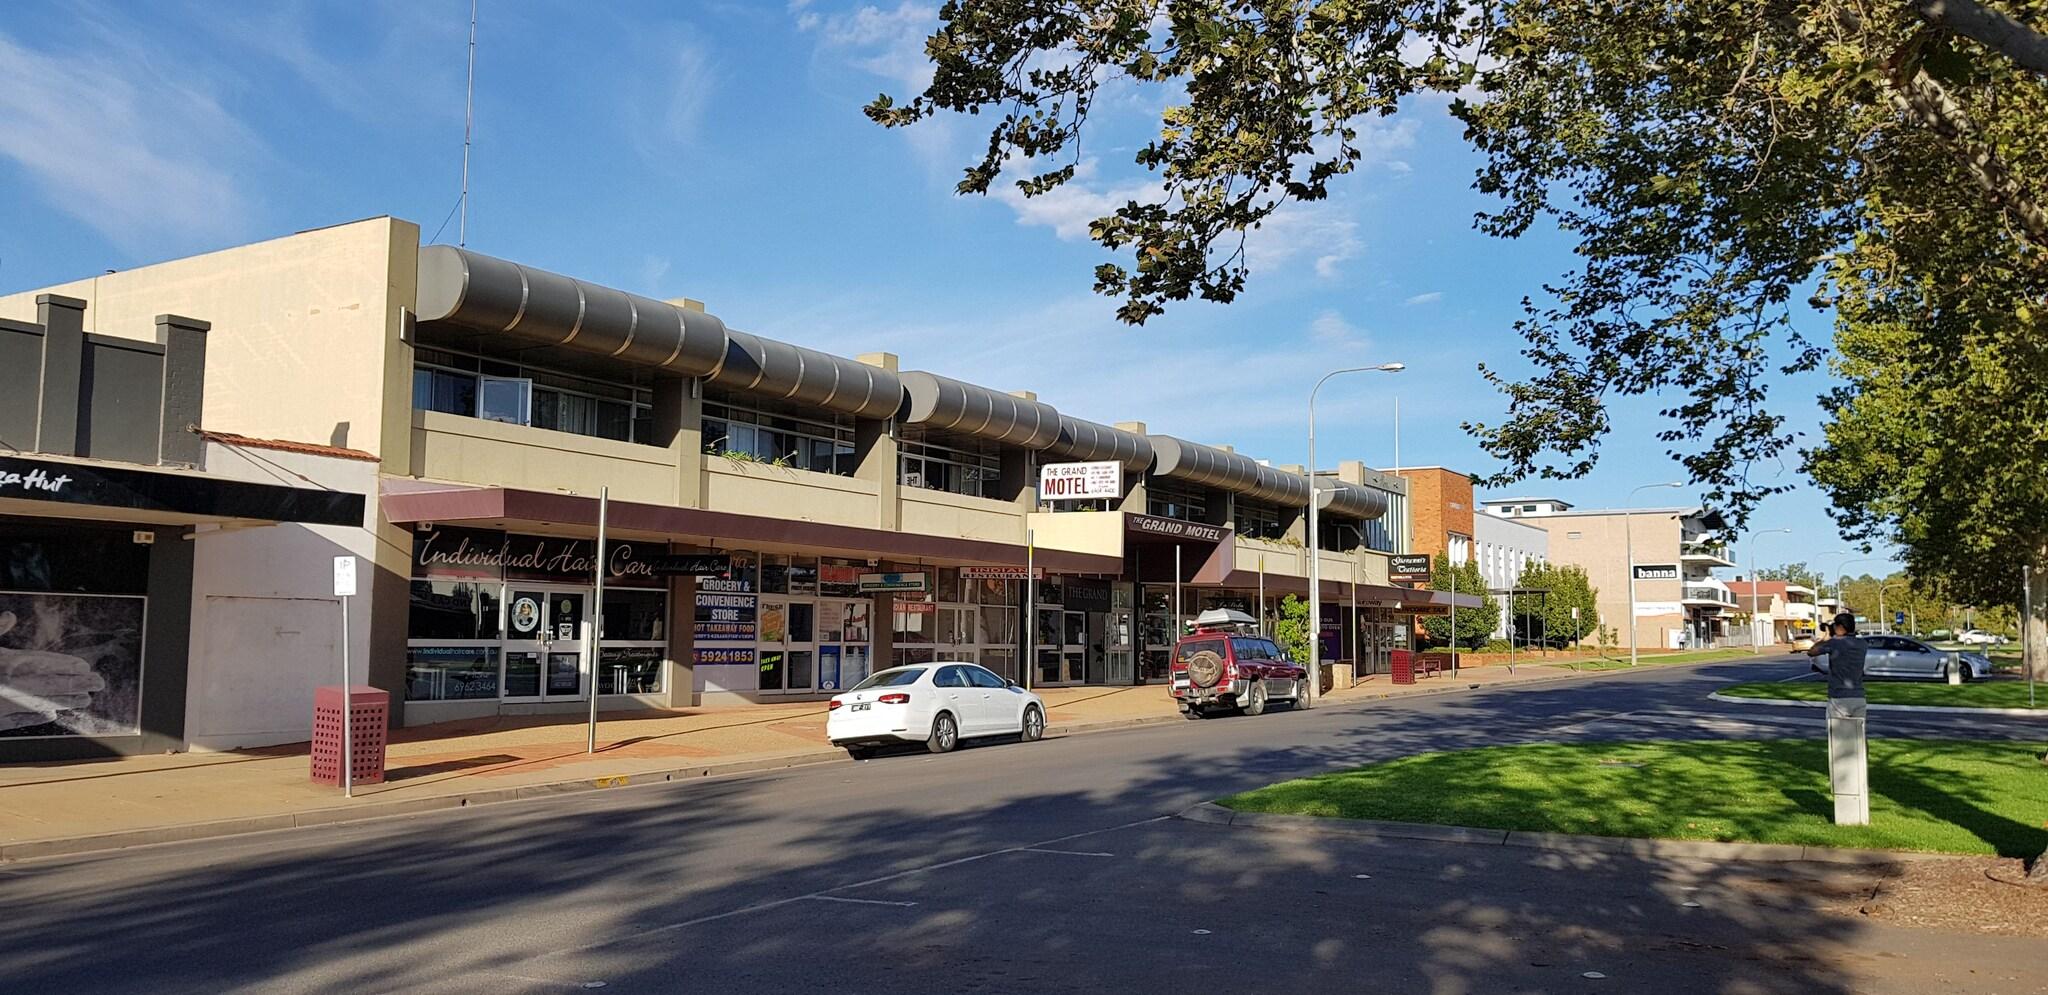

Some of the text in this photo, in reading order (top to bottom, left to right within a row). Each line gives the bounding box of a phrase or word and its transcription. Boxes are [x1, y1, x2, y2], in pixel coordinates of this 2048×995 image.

[1047, 468, 1058, 476] THE
[1061, 467, 1087, 476] GRAND
[23, 468, 73, 492] Hut
[1045, 477, 1089, 495] MOTEL
[1142, 519, 1182, 534] GRAND
[1185, 525, 1219, 540] MOTEL
[420, 531, 547, 568] Individual
[1638, 568, 1676, 578] banna
[702, 580, 750, 592] GROCERY &
[695, 595, 755, 608] CONVENIENCE
[712, 609, 739, 621] STORE
[706, 624, 737, 632] TAKEAWAY
[739, 624, 755, 633] FOOD
